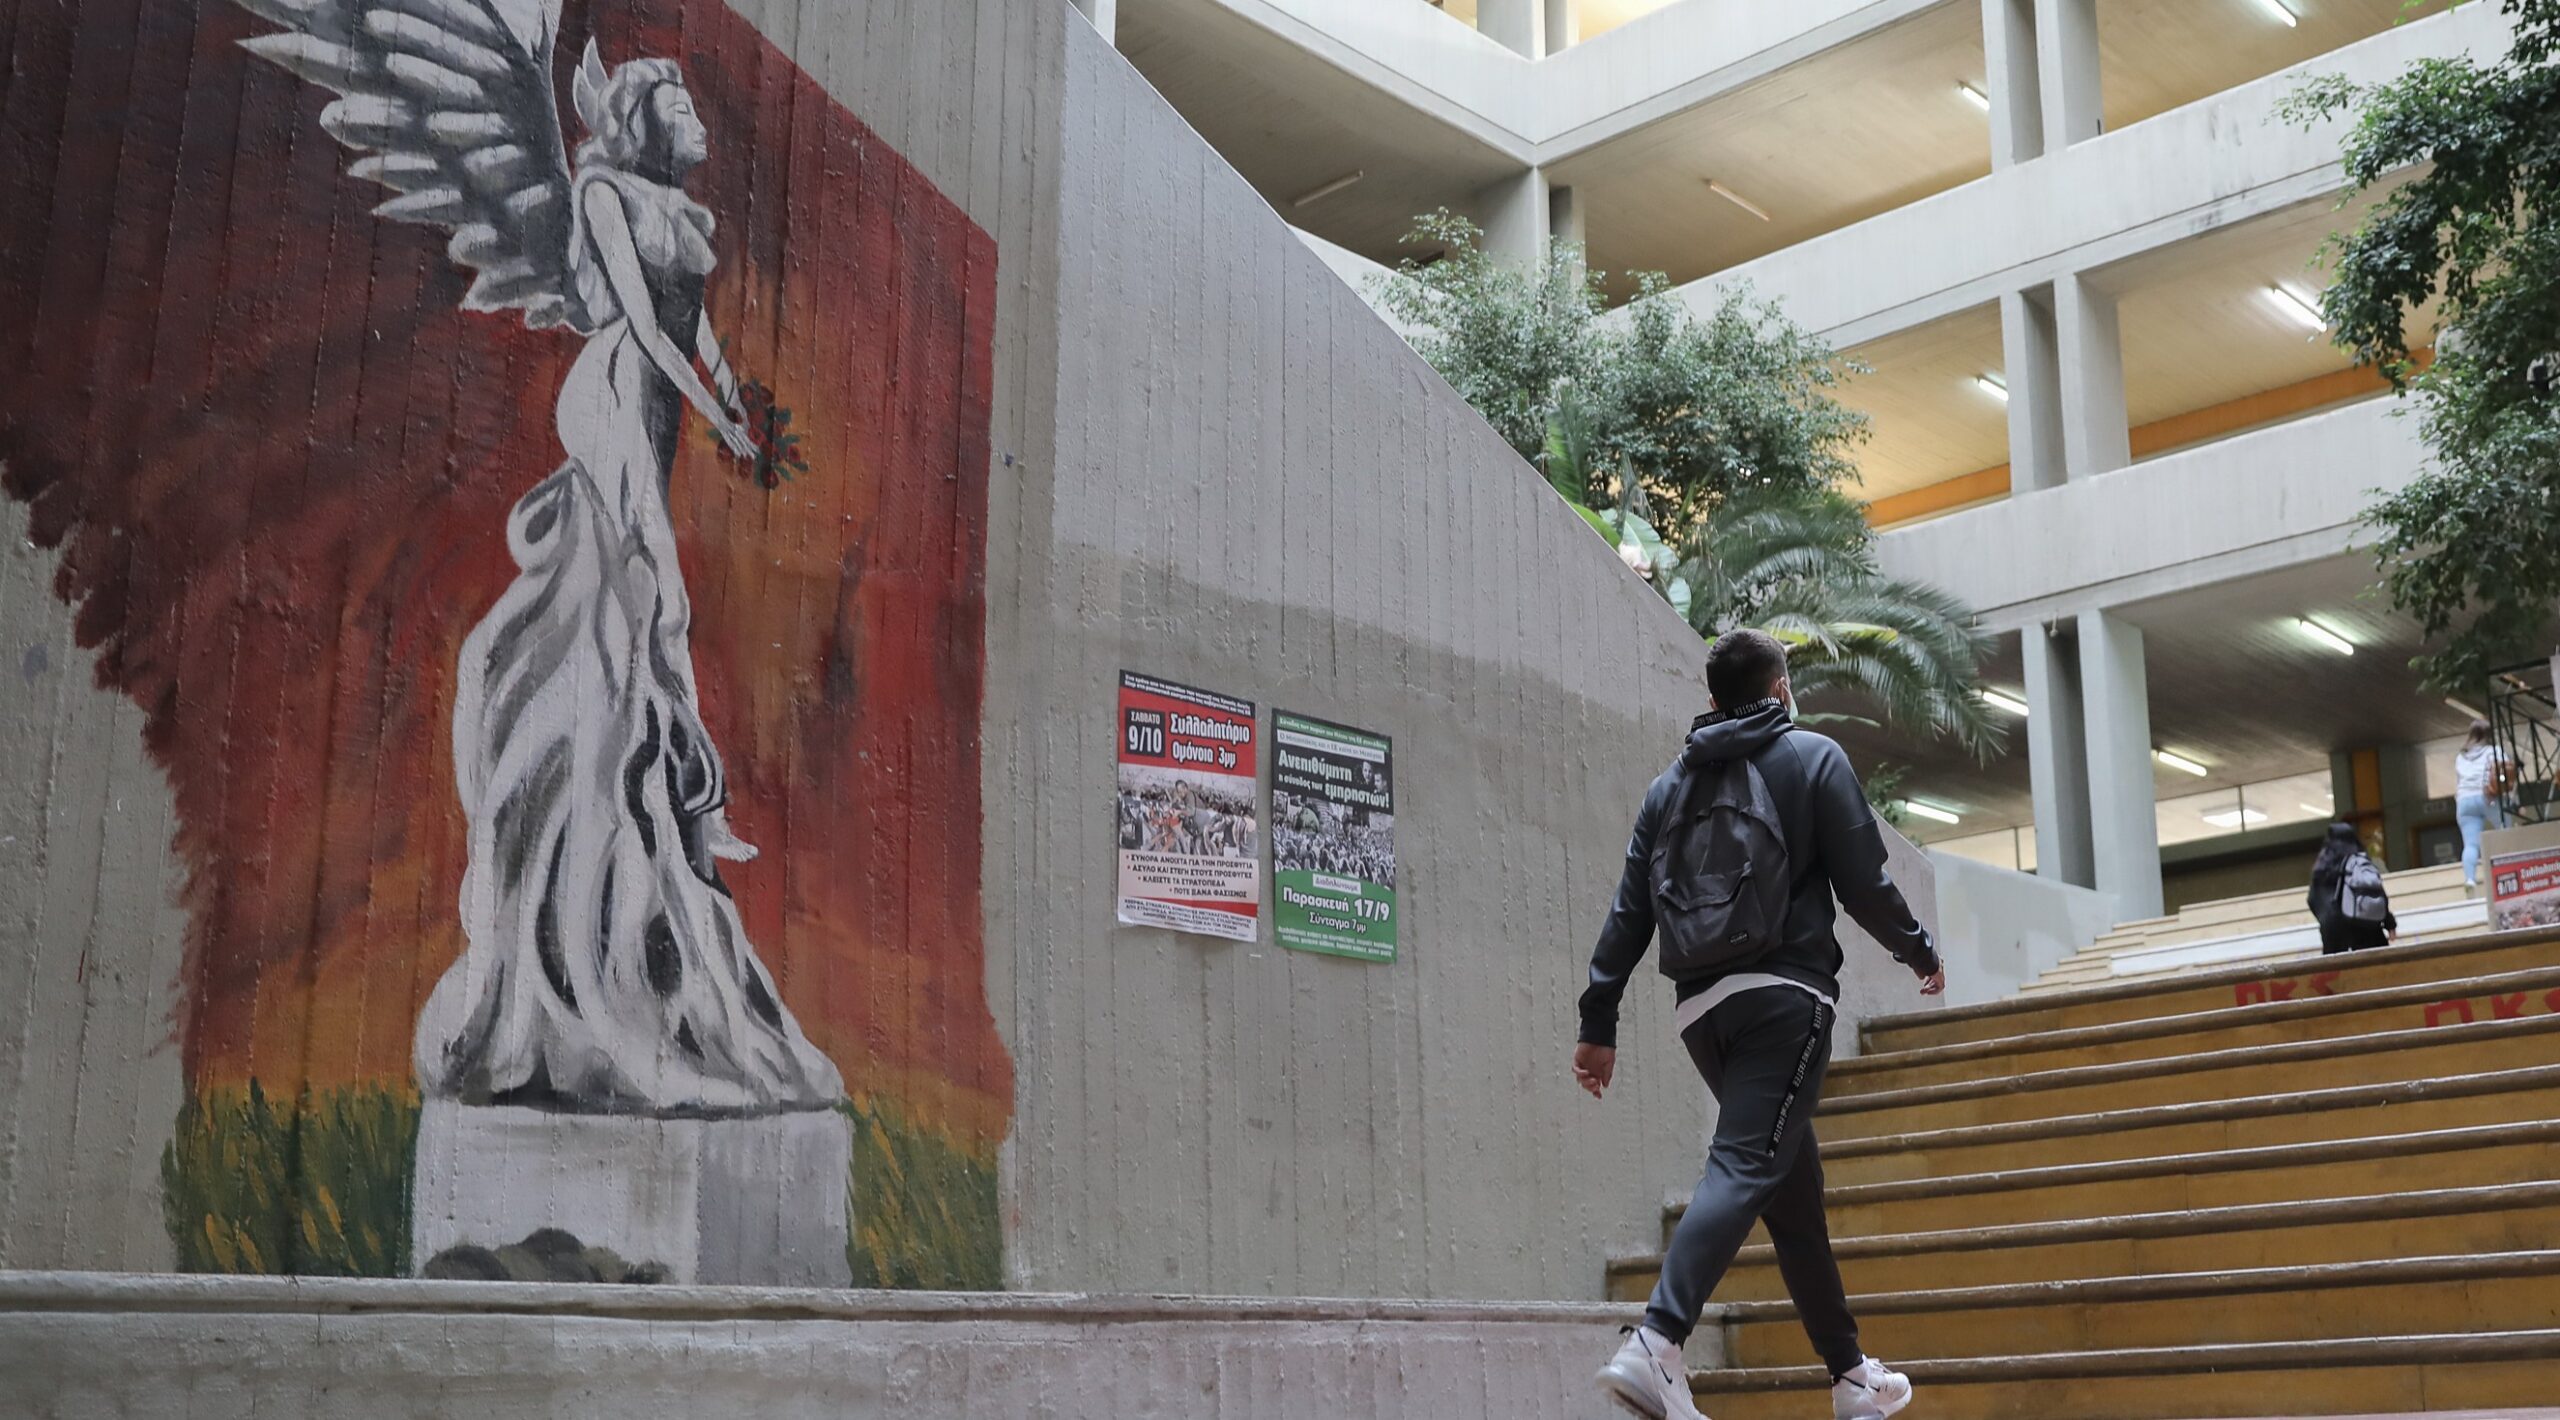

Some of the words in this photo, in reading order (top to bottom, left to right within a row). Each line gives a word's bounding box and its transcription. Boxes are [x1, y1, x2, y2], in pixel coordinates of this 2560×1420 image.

[1130, 711, 1161, 724] ΣΑΒΒΑΤΟ
[1170, 713, 1250, 745] Συλλαλητήριο
[1128, 725, 1162, 753] 9/10
[1172, 741, 1213, 763] Ομόνοια
[1218, 747, 1236, 768] 3μμ
[1278, 749, 1352, 782] Ανεπιθύμητη
[1325, 783, 1389, 808] εμπρηστών!
[1131, 855, 1159, 863] ΣΥΝΟΡΑ
[1283, 886, 1349, 912] Παρασκευή
[1354, 898, 1390, 922] 17/9
[1309, 911, 1350, 931] Σύνταγμα
[1352, 918, 1367, 933] 7μμ
